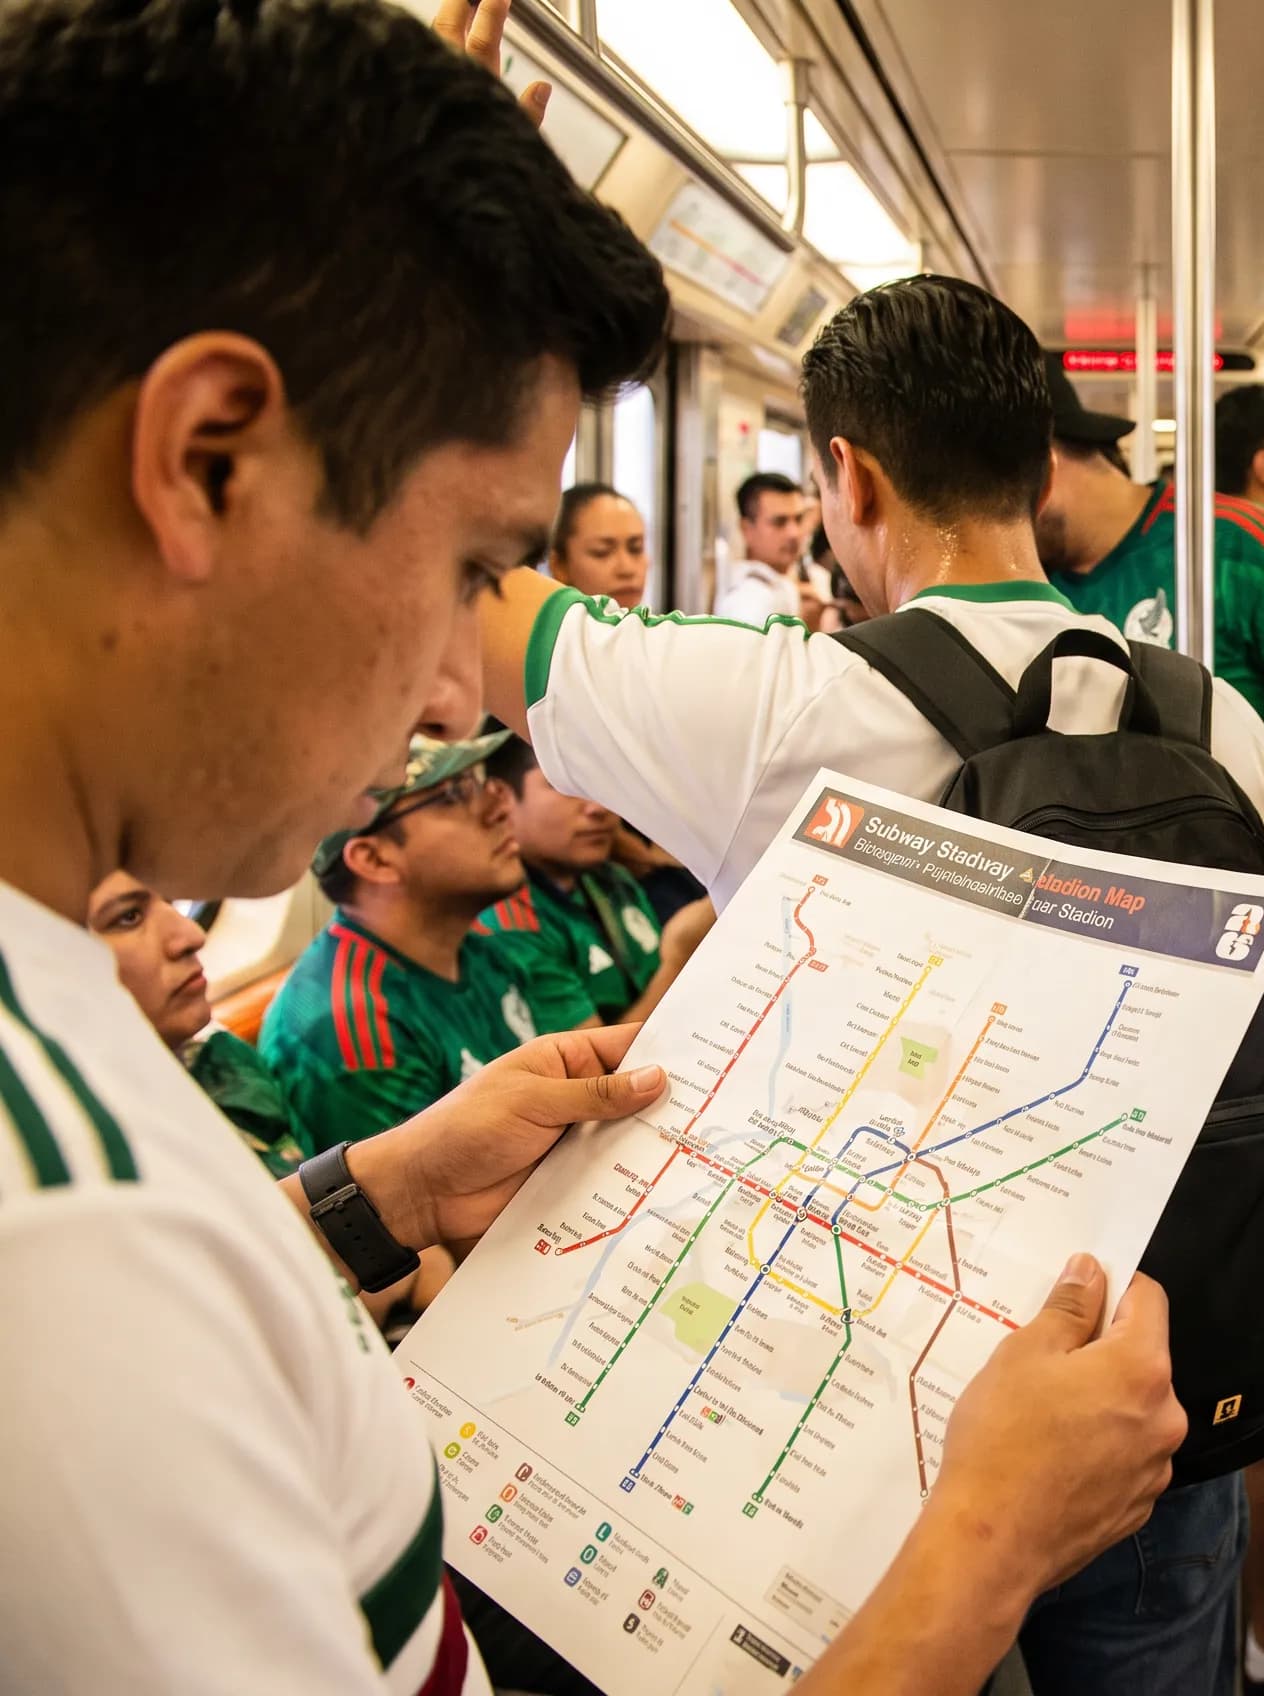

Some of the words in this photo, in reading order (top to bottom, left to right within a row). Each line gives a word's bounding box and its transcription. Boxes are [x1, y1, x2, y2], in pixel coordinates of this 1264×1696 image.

[864, 815, 935, 855] Subway
[1103, 886, 1146, 914] Map
[1057, 903, 1115, 929] Stadion
